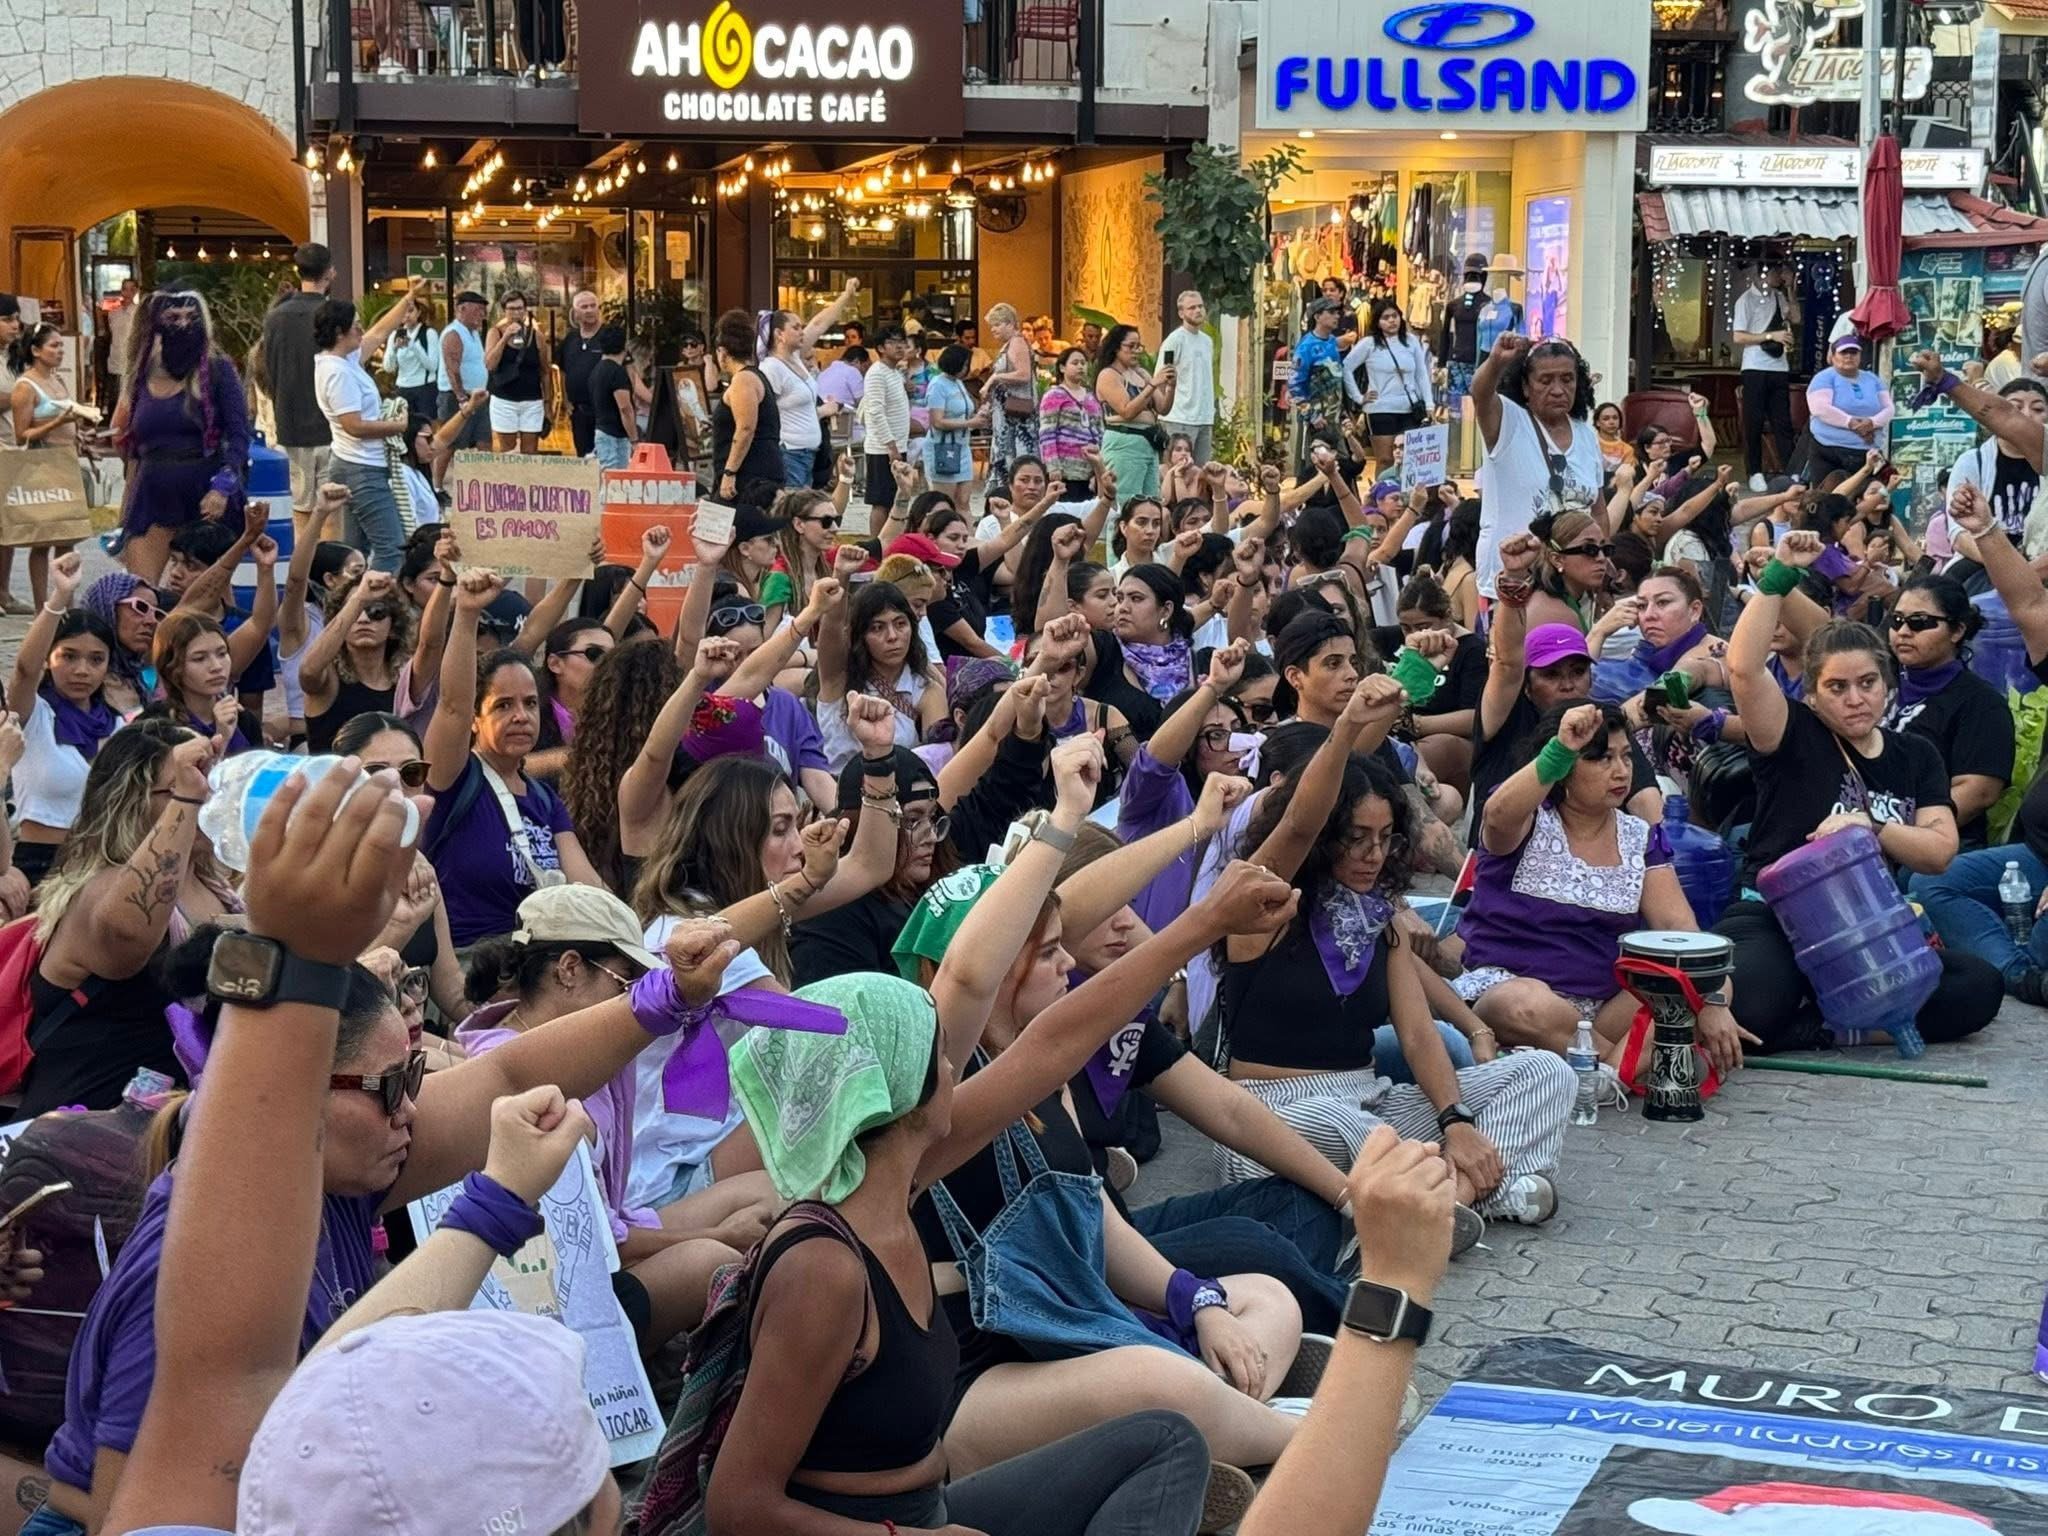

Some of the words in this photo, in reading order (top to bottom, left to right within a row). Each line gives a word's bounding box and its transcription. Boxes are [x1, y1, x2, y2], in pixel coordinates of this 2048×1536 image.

[1275, 56, 1637, 112] FULLSAND
[664, 91, 813, 121] CHOCOLATE
[820, 88, 887, 122] CAFÉ
[7, 485, 73, 506] shasa
[457, 479, 481, 512] LA
[484, 481, 527, 513] LUCHA
[529, 484, 592, 514] COLECTIVA
[475, 517, 498, 540] ES
[502, 517, 560, 542] AMOR
[607, 1384, 640, 1402] niñas
[1583, 1363, 1953, 1421] MURO
[1439, 1442, 1453, 1451] 8
[1457, 1444, 1486, 1455] de
[1490, 1448, 1565, 1460] marzo
[1570, 1452, 1600, 1464] de
[1484, 1457, 1544, 1469] 2024
[1970, 1450, 2048, 1472] Ins
[1448, 1499, 1549, 1517] Violencia
[1425, 1516, 1515, 1531] violencia
